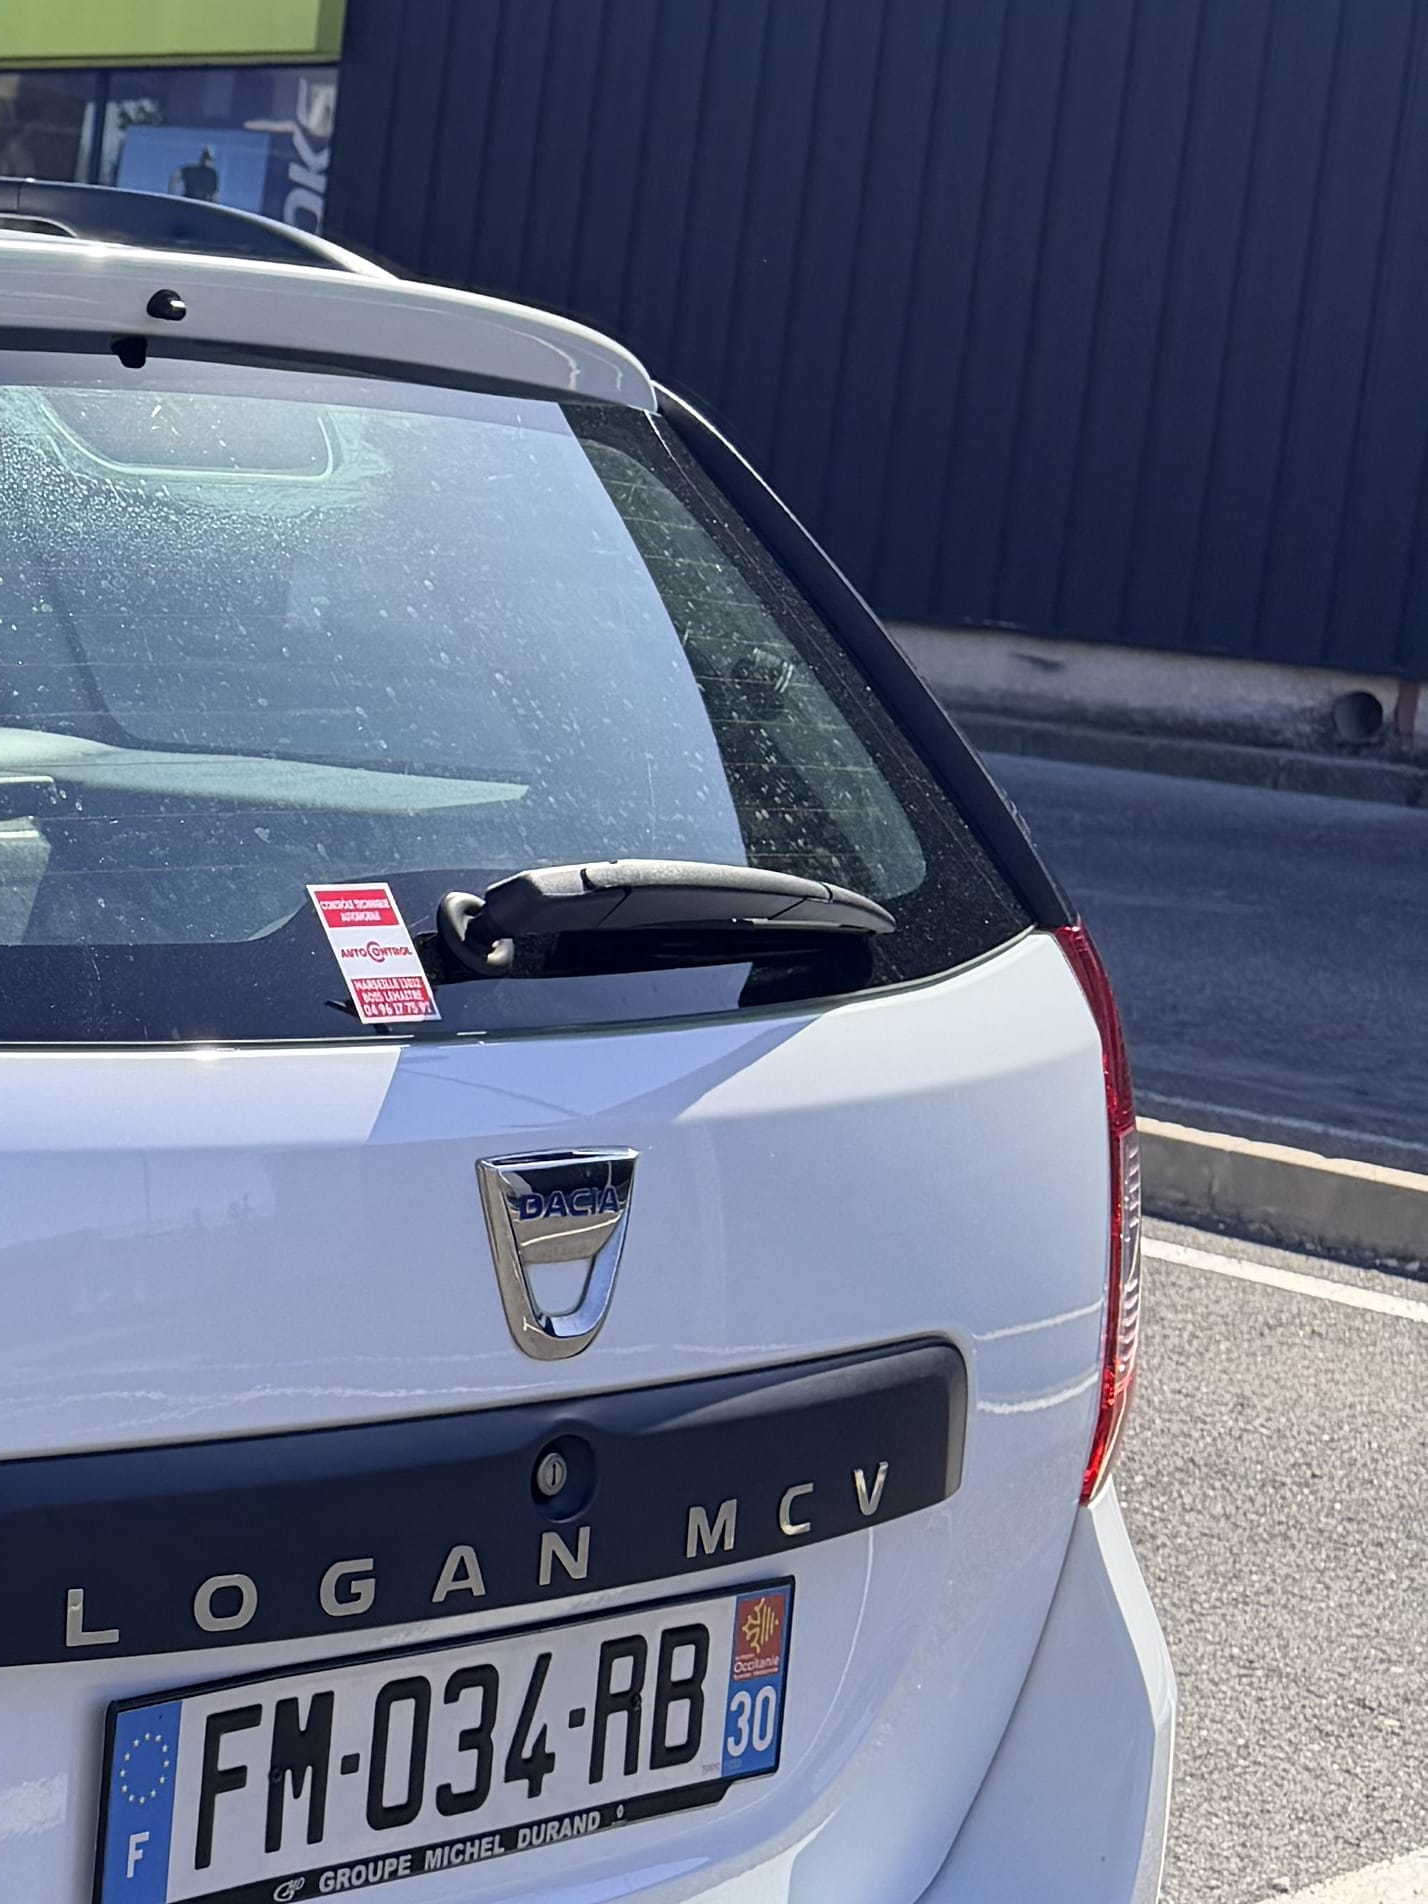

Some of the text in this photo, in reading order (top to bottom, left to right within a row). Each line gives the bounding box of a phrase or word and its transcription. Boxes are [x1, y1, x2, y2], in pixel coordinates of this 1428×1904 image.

[520, 1187, 620, 1220] DACIA
[64, 1460, 891, 1648] LOGAN MCV
[193, 1621, 710, 1869] FM-034-RB
[726, 1685, 778, 1758] 30
[125, 1834, 152, 1880] F
[318, 1854, 412, 1895] GROUPE
[423, 1835, 505, 1871] MICHEL
[517, 1810, 602, 1848] DURAND
